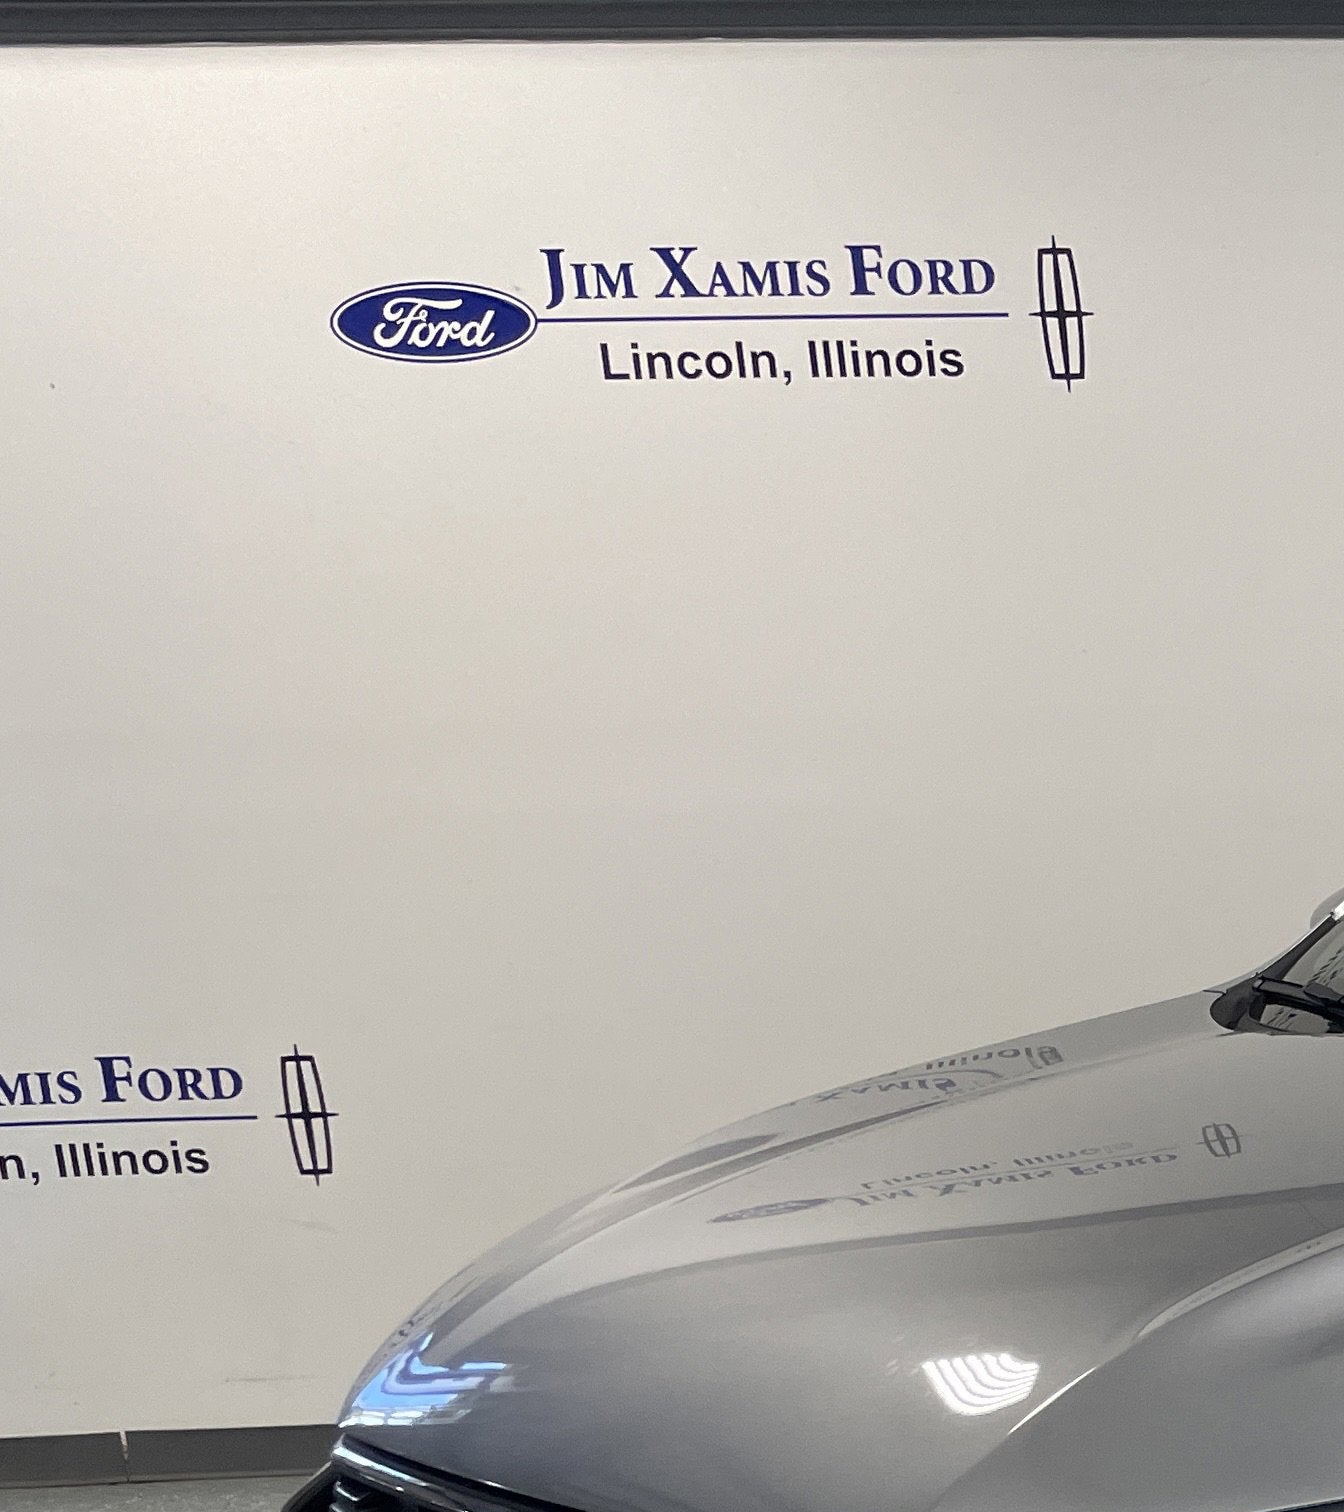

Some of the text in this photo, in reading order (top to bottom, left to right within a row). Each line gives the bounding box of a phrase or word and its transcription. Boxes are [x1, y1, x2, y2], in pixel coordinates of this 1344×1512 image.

[539, 244, 996, 310] JIM XAMIS FORD
[373, 297, 495, 349] Ford
[599, 338, 966, 387] Lincoln, Illinois
[93, 1055, 244, 1104] FORD
[54, 1140, 211, 1178] Illinois
